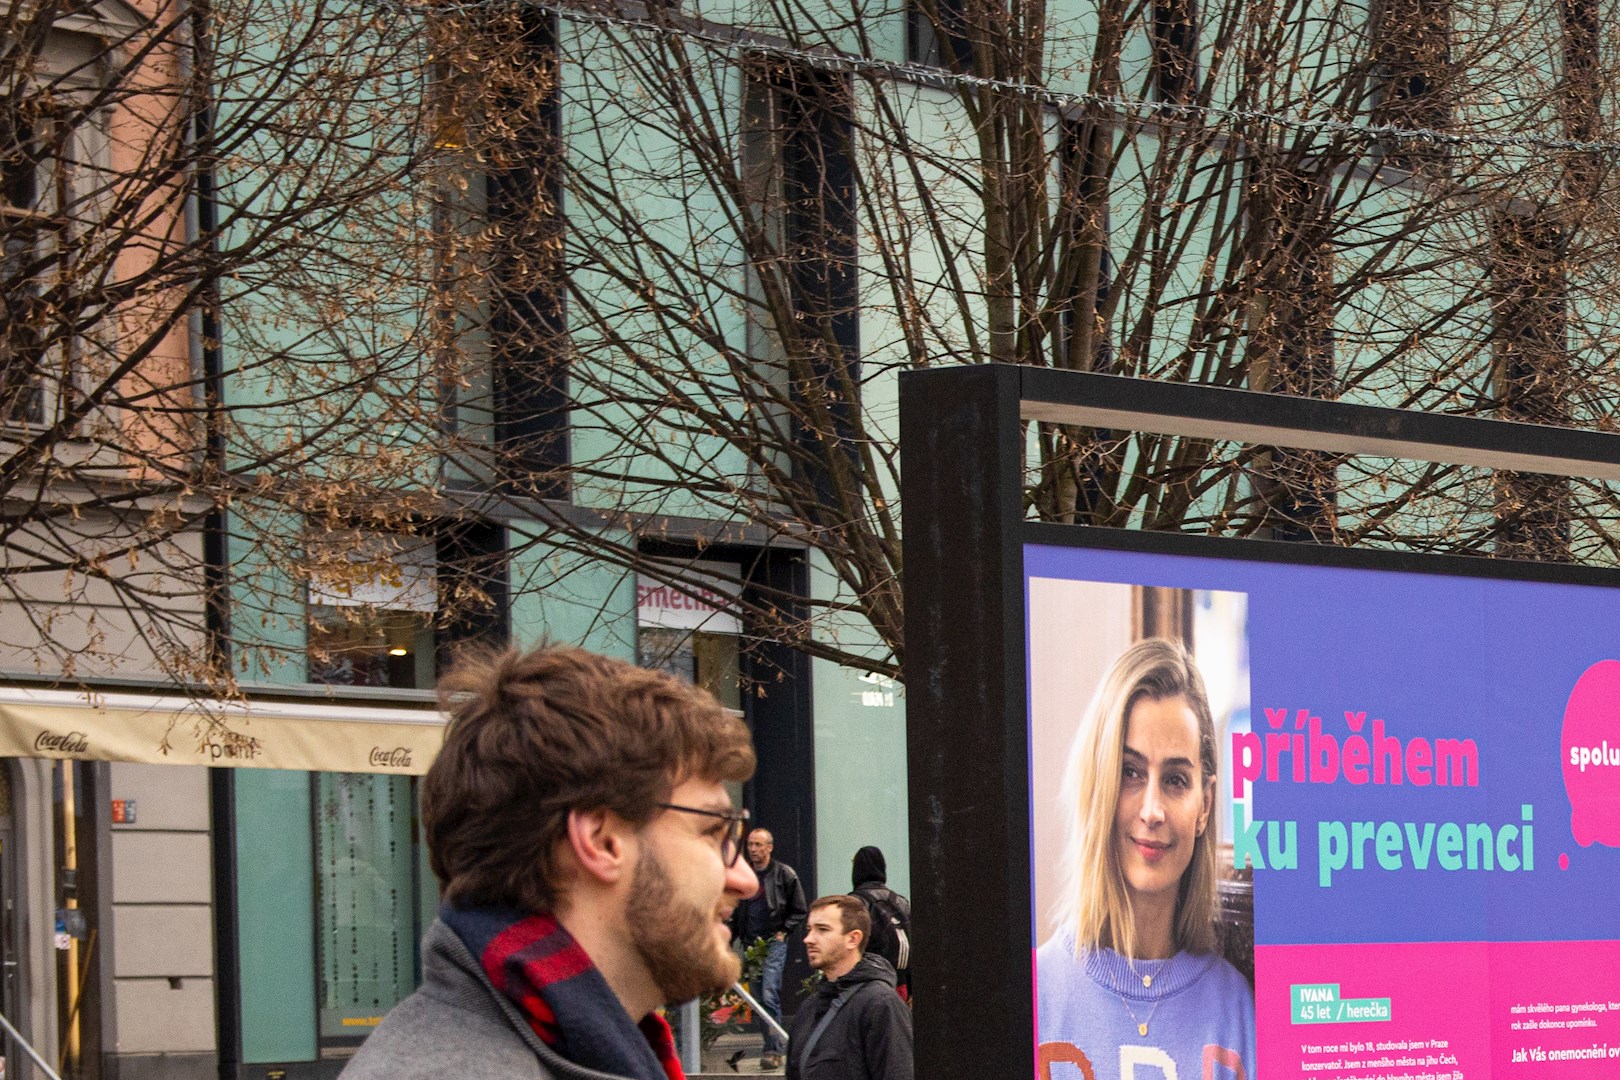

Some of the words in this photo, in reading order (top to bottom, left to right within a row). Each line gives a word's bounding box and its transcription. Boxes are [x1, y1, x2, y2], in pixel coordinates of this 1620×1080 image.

[1231, 708, 1479, 799] příběhem
[1232, 804, 1298, 870] ku
[1318, 805, 1534, 887] prevenci
[1300, 988, 1334, 1003] IVANA
[1300, 1005, 1314, 1020] 45
[1316, 1004, 1331, 1020] let
[1347, 1002, 1388, 1019] herečka
[1308, 1045, 1322, 1053] tom
[1431, 1039, 1448, 1048] Praze
[1512, 1048, 1528, 1062] Jak
[1529, 1046, 1546, 1061] Vás
[1548, 1044, 1607, 1060] onemocnění
